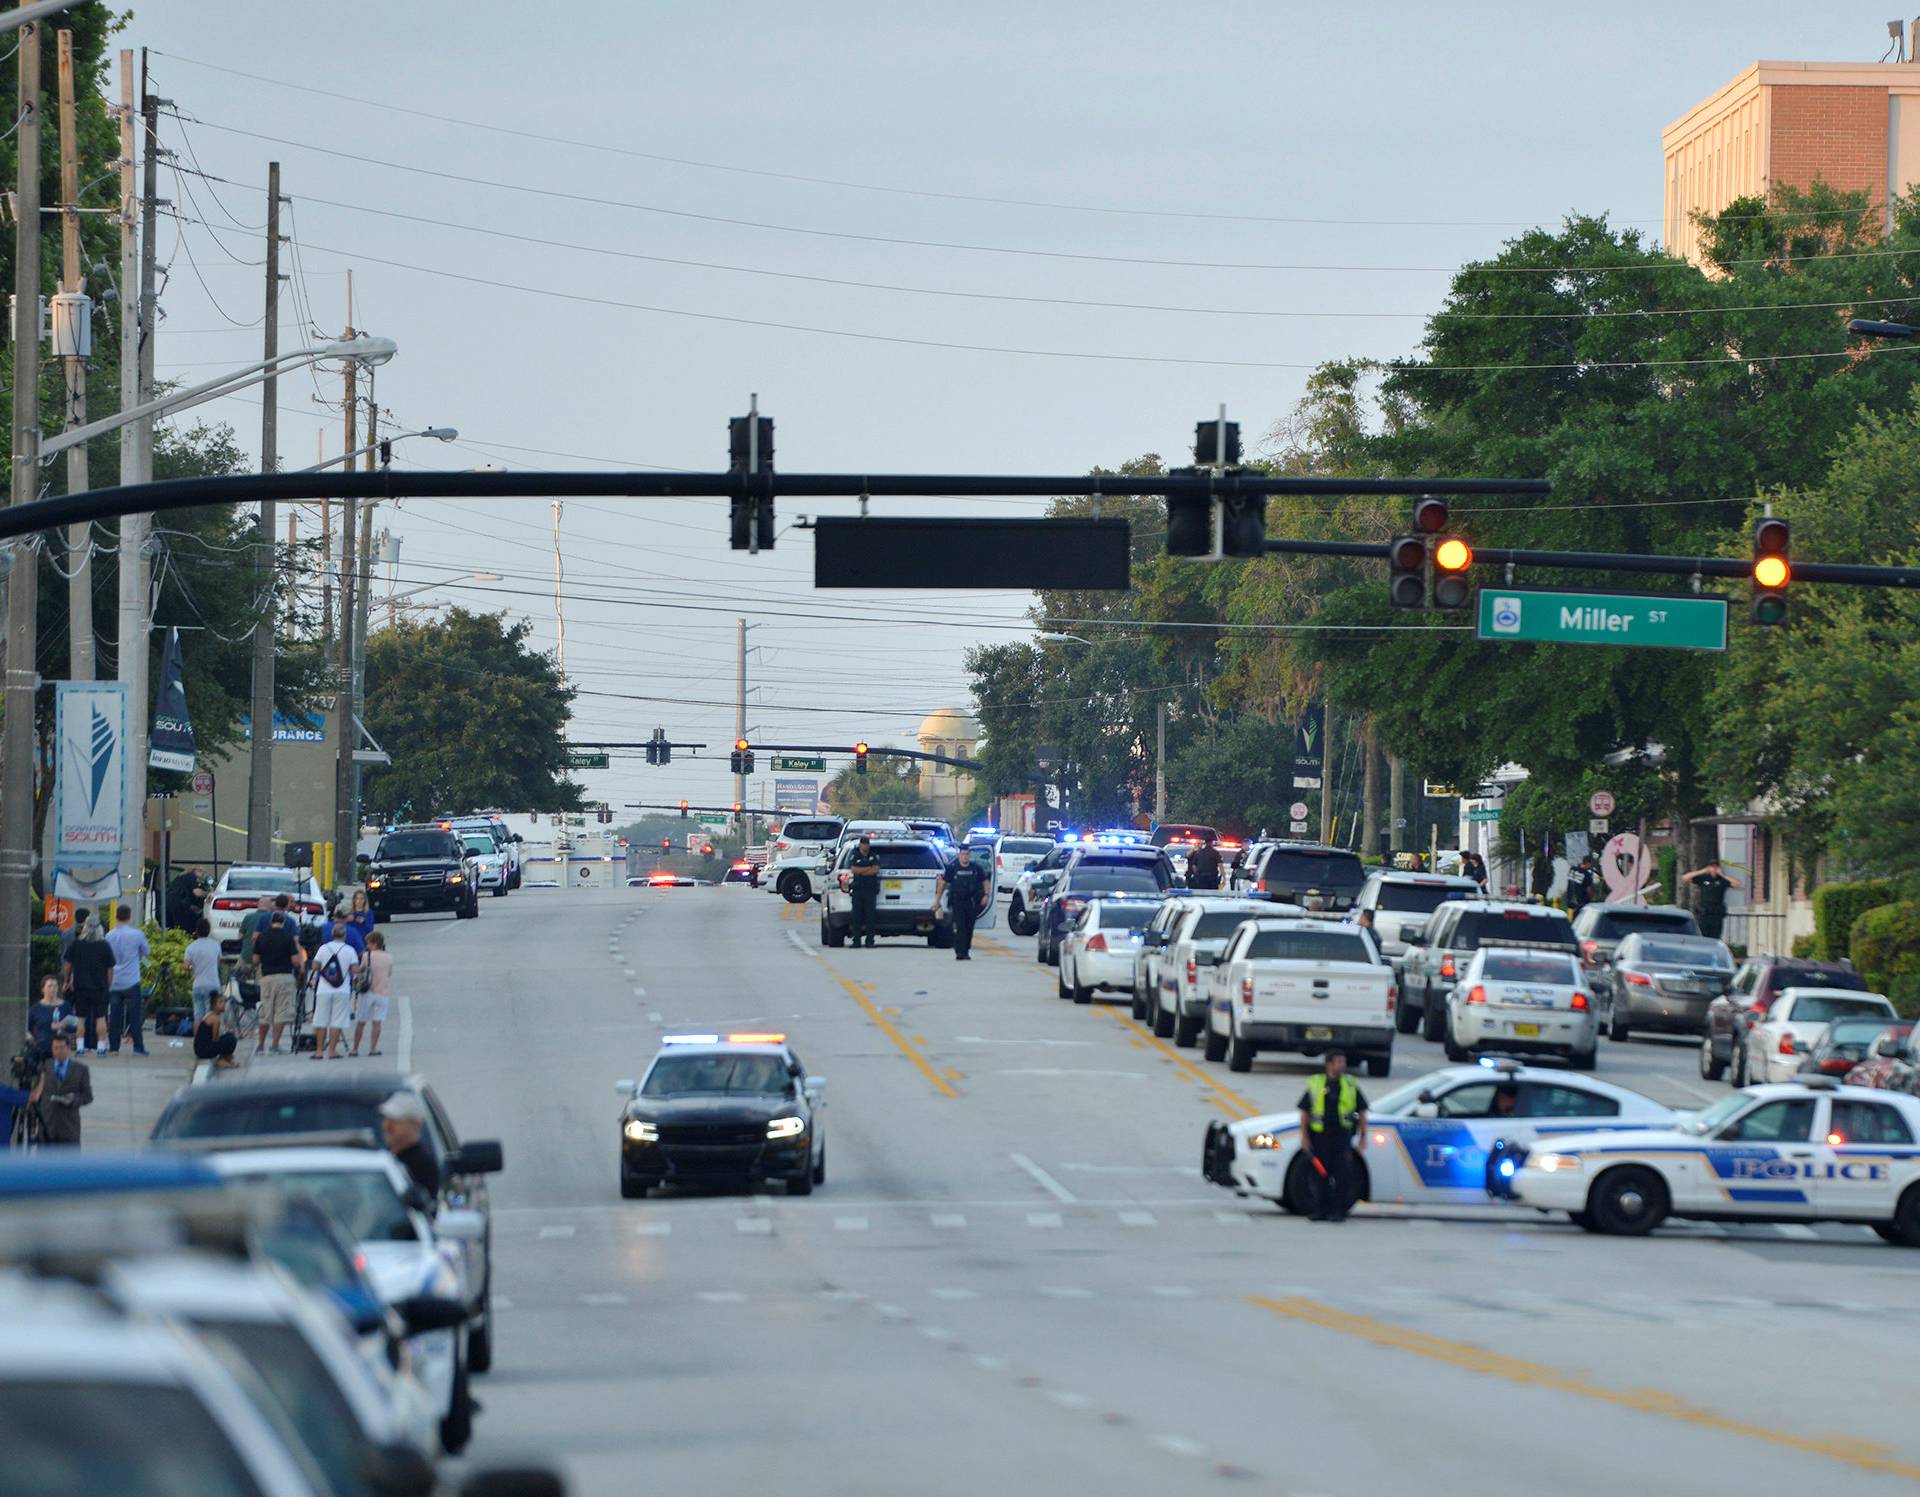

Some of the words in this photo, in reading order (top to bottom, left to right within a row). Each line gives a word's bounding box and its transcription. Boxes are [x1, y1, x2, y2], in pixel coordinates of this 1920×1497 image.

[1559, 606, 1635, 632] Miller
[1647, 610, 1668, 623] ST
[1732, 1157, 1890, 1182] POLICE
